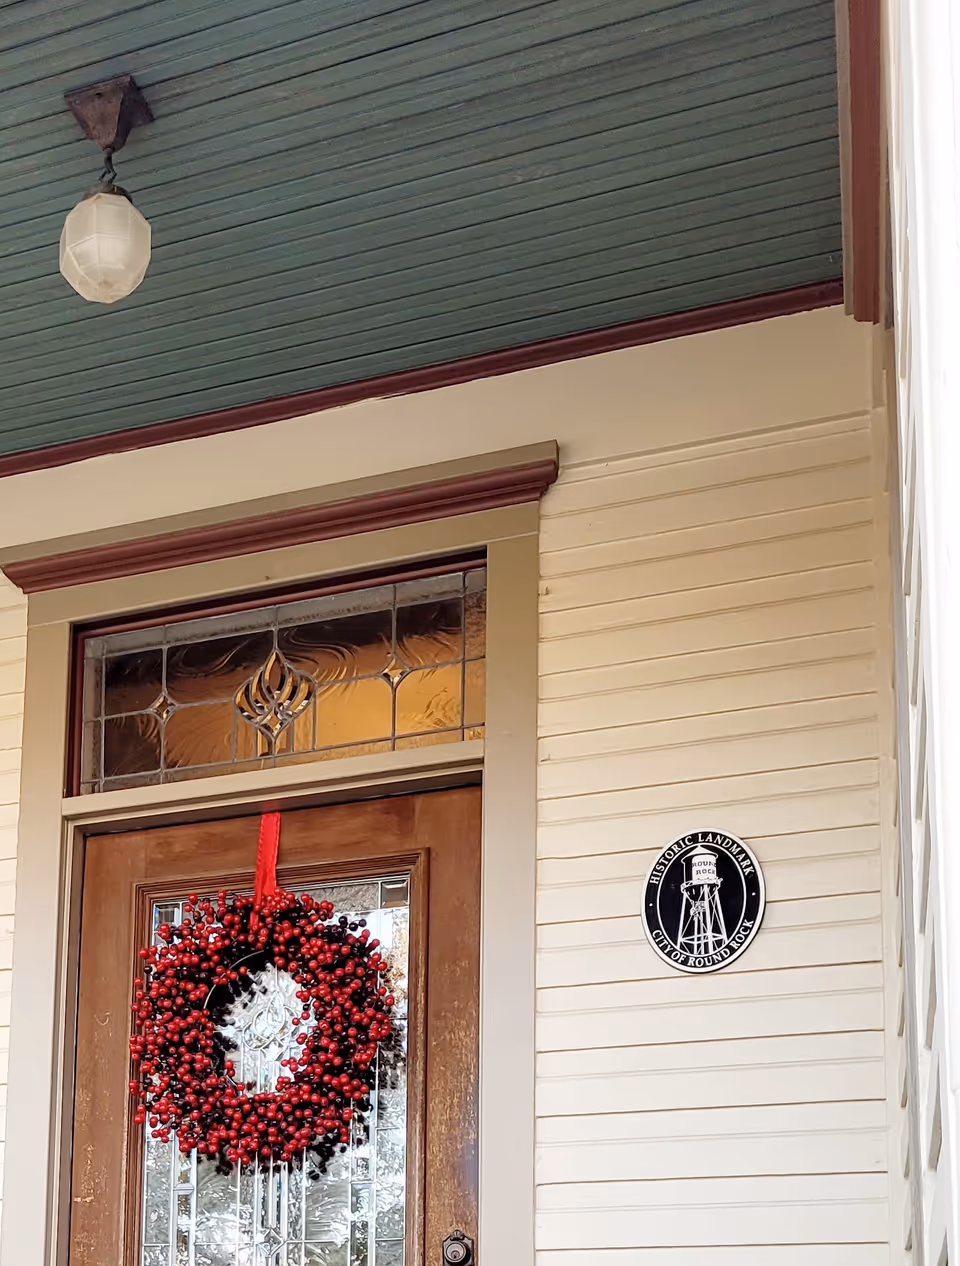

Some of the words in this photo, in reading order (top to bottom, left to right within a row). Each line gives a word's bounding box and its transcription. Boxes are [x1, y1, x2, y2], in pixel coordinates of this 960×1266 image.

[650, 836, 693, 885] HISTORIC
[698, 832, 755, 876] LANDMARK
[652, 929, 672, 954] CITY
[670, 949, 687, 964] OF
[688, 948, 731, 968] ROUND
[733, 919, 754, 950] ROCK
